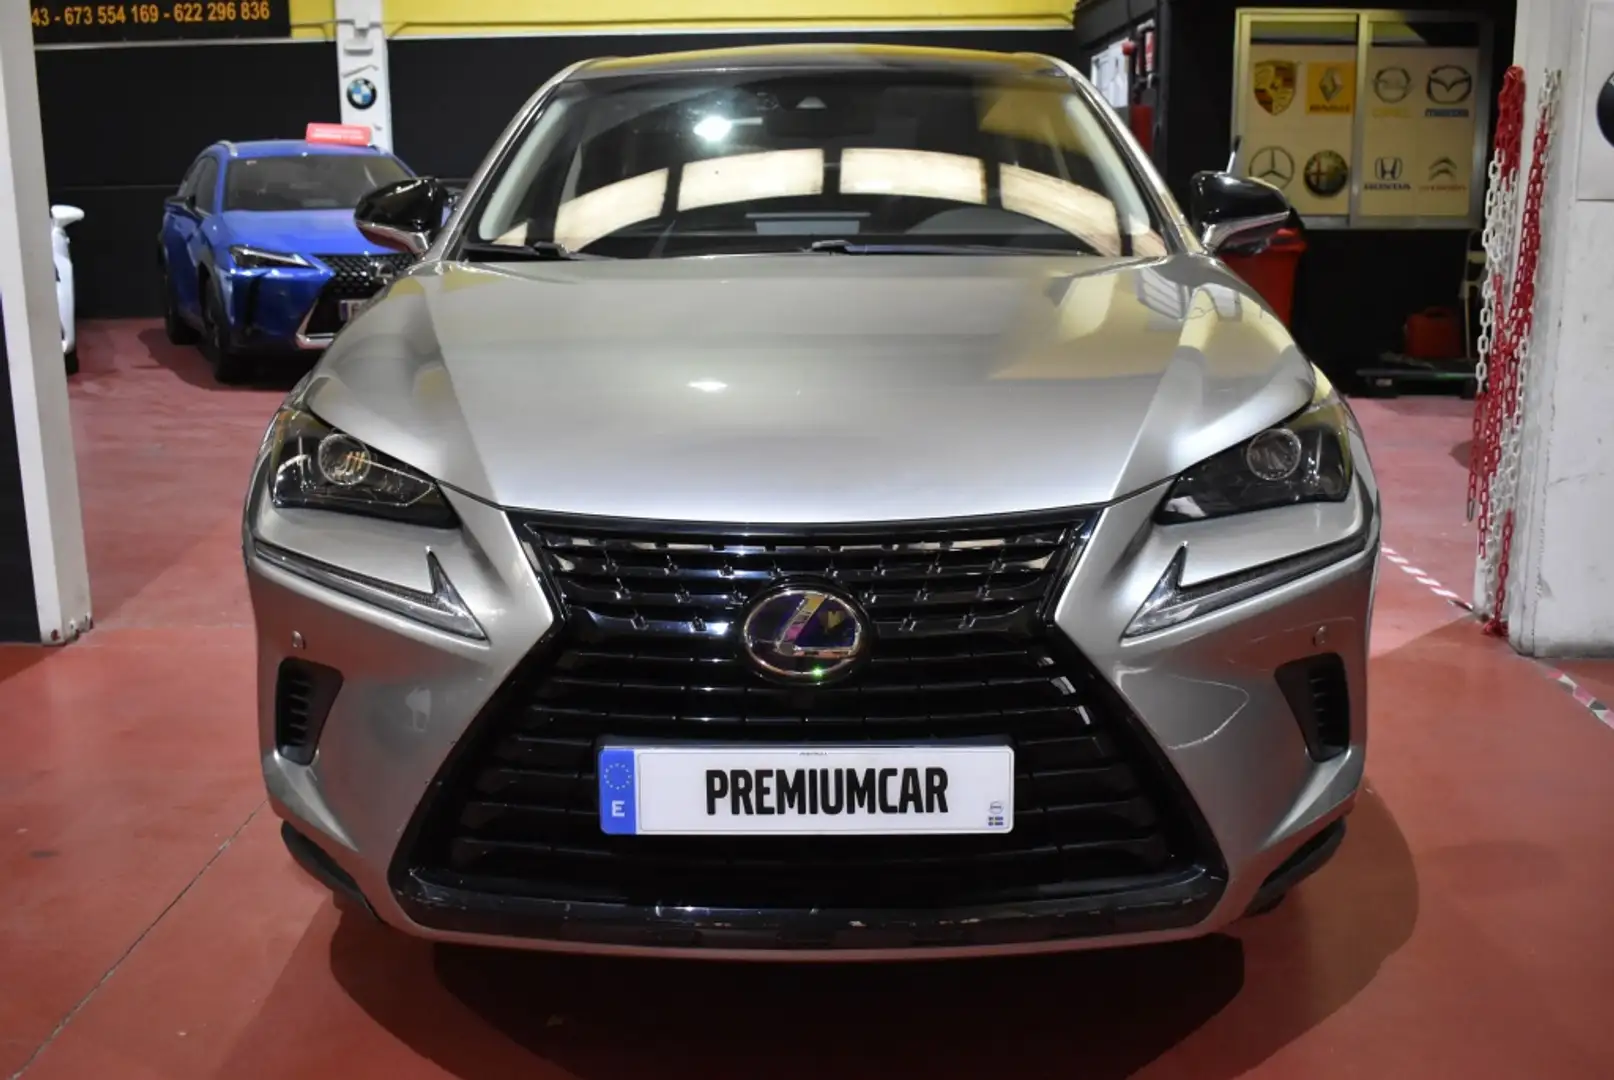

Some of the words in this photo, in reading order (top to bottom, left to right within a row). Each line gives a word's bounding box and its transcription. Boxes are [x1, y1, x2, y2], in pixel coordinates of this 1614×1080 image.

[64, 6, 93, 25] 673
[97, 5, 126, 24] 554
[131, 3, 159, 23] 169
[173, 3, 203, 22] 622
[207, 2, 236, 21] 296
[240, 1, 270, 20] 836
[705, 767, 949, 816] PREMIUMCAR
[611, 800, 626, 817] E
